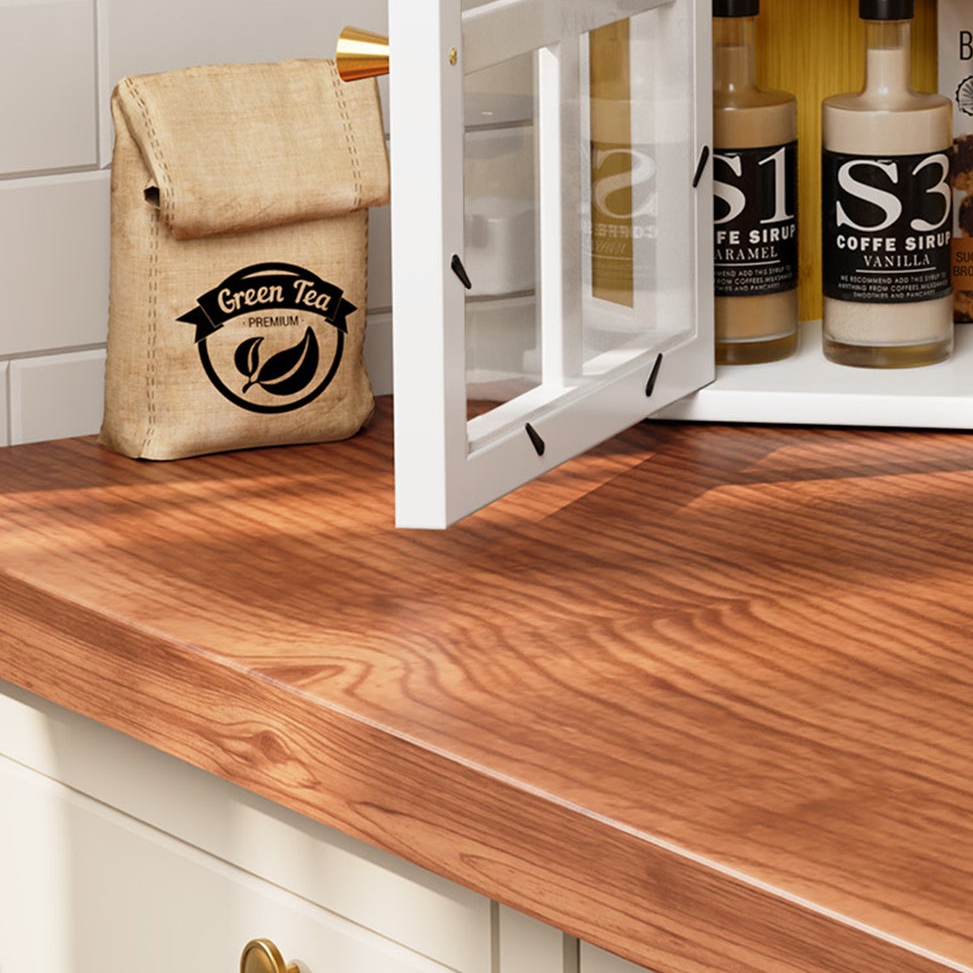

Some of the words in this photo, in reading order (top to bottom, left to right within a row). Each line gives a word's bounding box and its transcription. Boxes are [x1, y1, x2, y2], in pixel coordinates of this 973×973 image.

[836, 153, 951, 233] S3
[749, 224, 796, 245] SIRUP
[836, 234, 897, 252] COFFE
[905, 231, 951, 251] SIRUP
[863, 254, 931, 268] VANILLA
[738, 269, 754, 277] ADD
[849, 275, 893, 285] RECOMMEND
[894, 276, 909, 284] ADD
[868, 284, 889, 292] FROM
[217, 285, 285, 314] Green
[293, 279, 332, 311] Tea
[248, 315, 299, 328] PREMIUM
